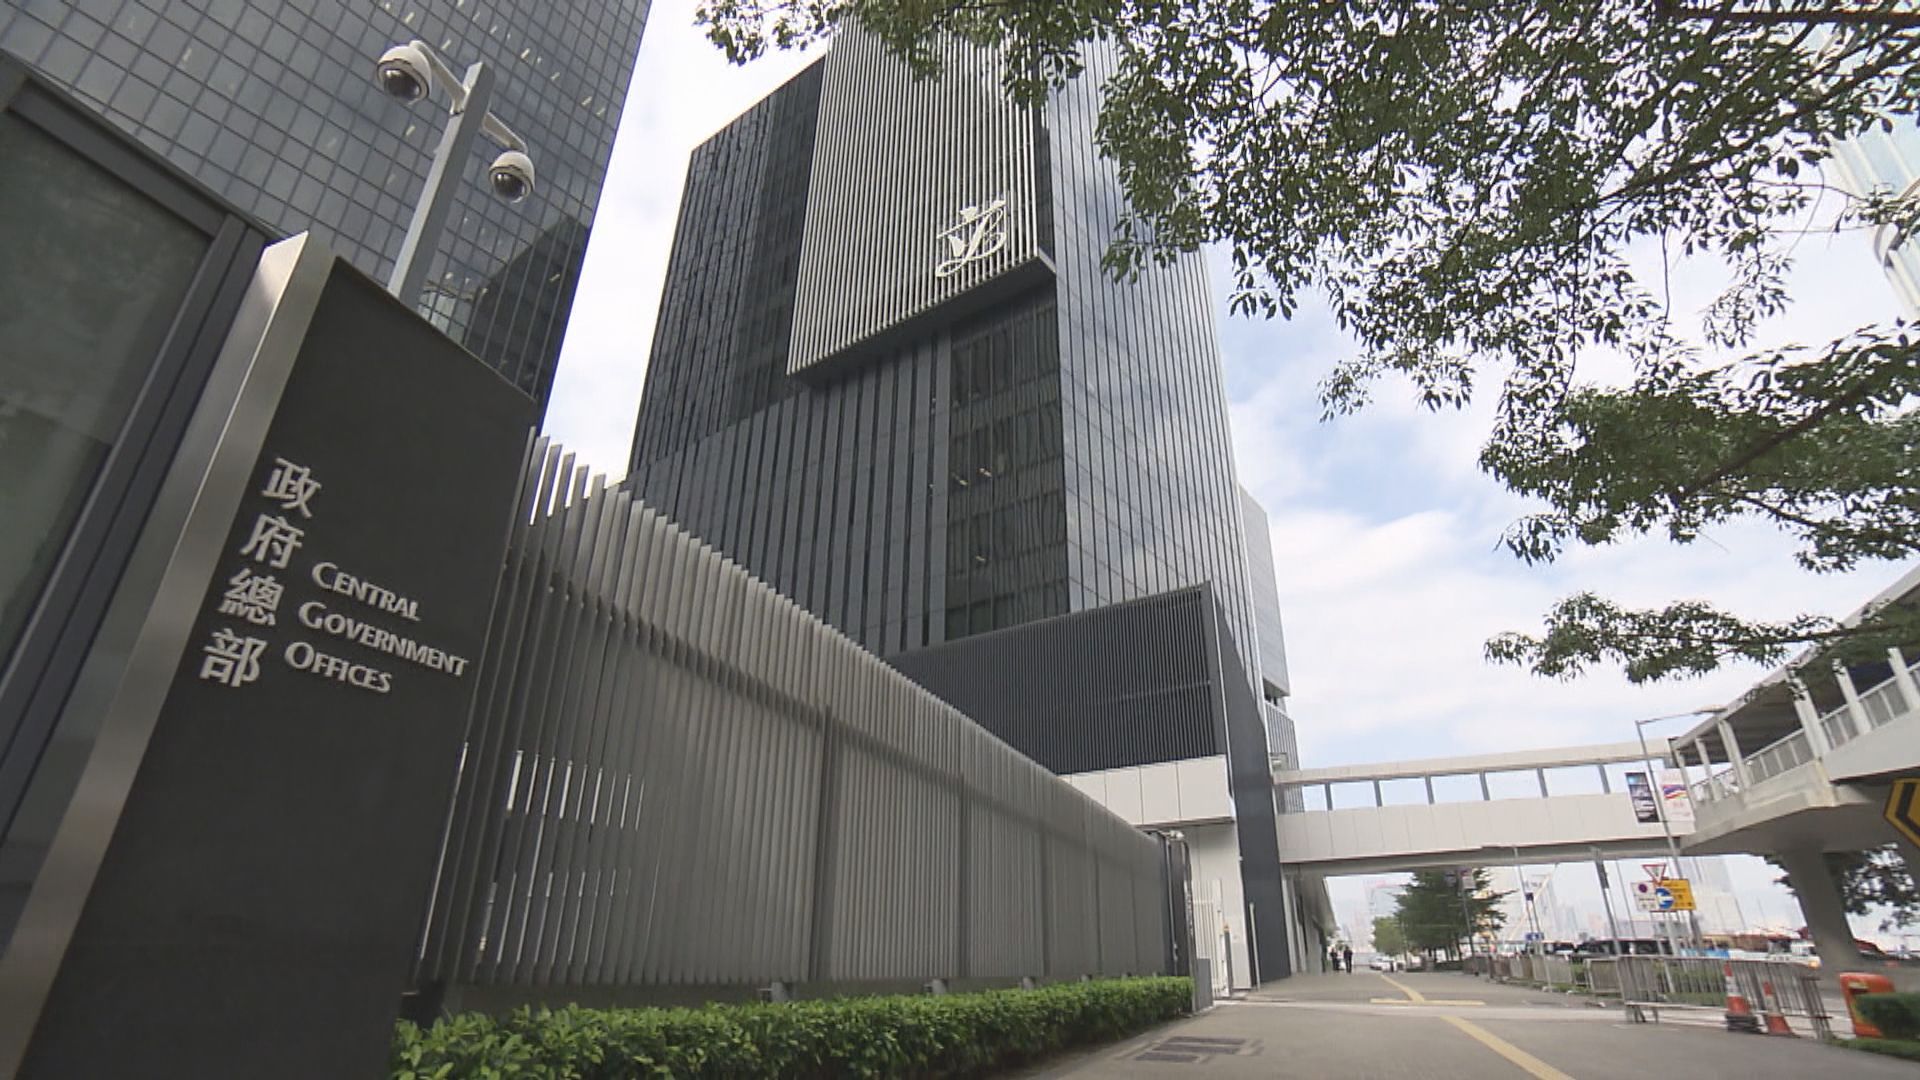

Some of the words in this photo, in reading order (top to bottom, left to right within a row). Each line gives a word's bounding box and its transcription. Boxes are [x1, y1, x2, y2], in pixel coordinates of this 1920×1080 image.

[200, 457, 322, 687] 政府總部
[311, 562, 421, 621] CENTRAL
[284, 641, 392, 693] OFFICES
[298, 601, 469, 676] GOVERNMENT
